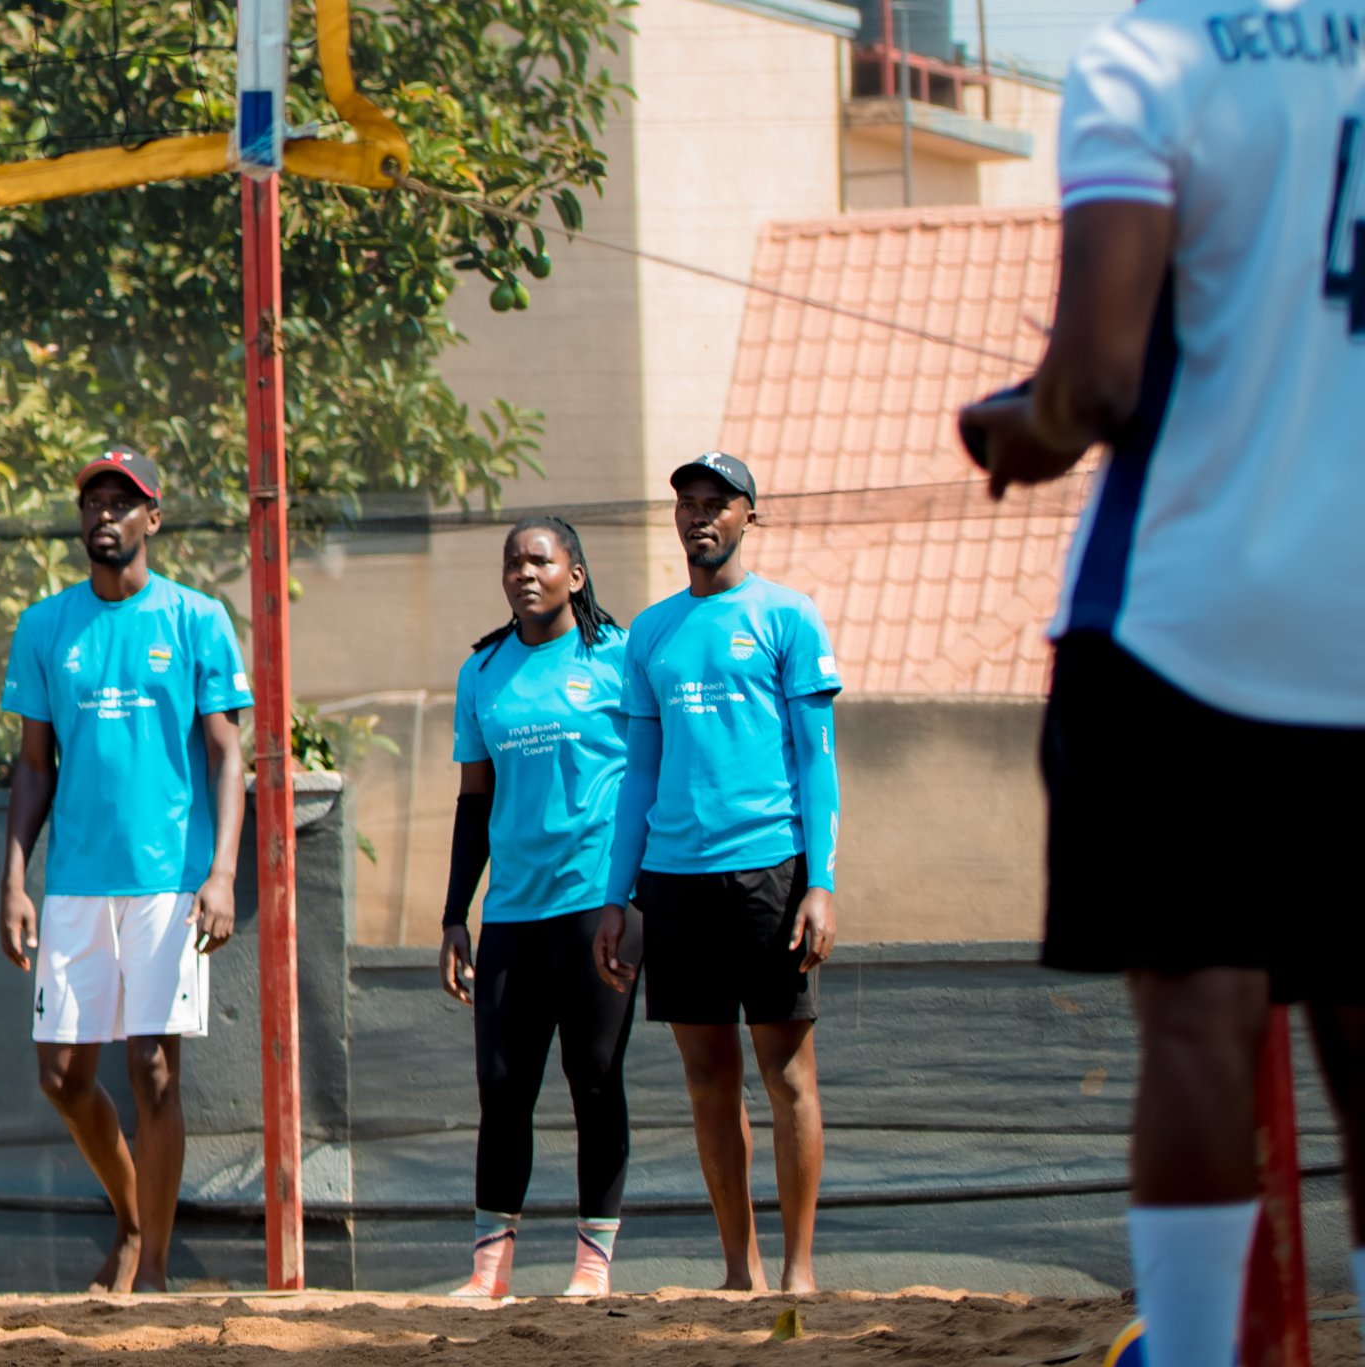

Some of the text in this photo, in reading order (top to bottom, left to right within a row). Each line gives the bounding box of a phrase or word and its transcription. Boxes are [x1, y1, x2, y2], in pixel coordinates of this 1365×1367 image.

[531, 721, 561, 733] Beach
[540, 731, 581, 743] Coaches
[523, 745, 554, 757] Course
